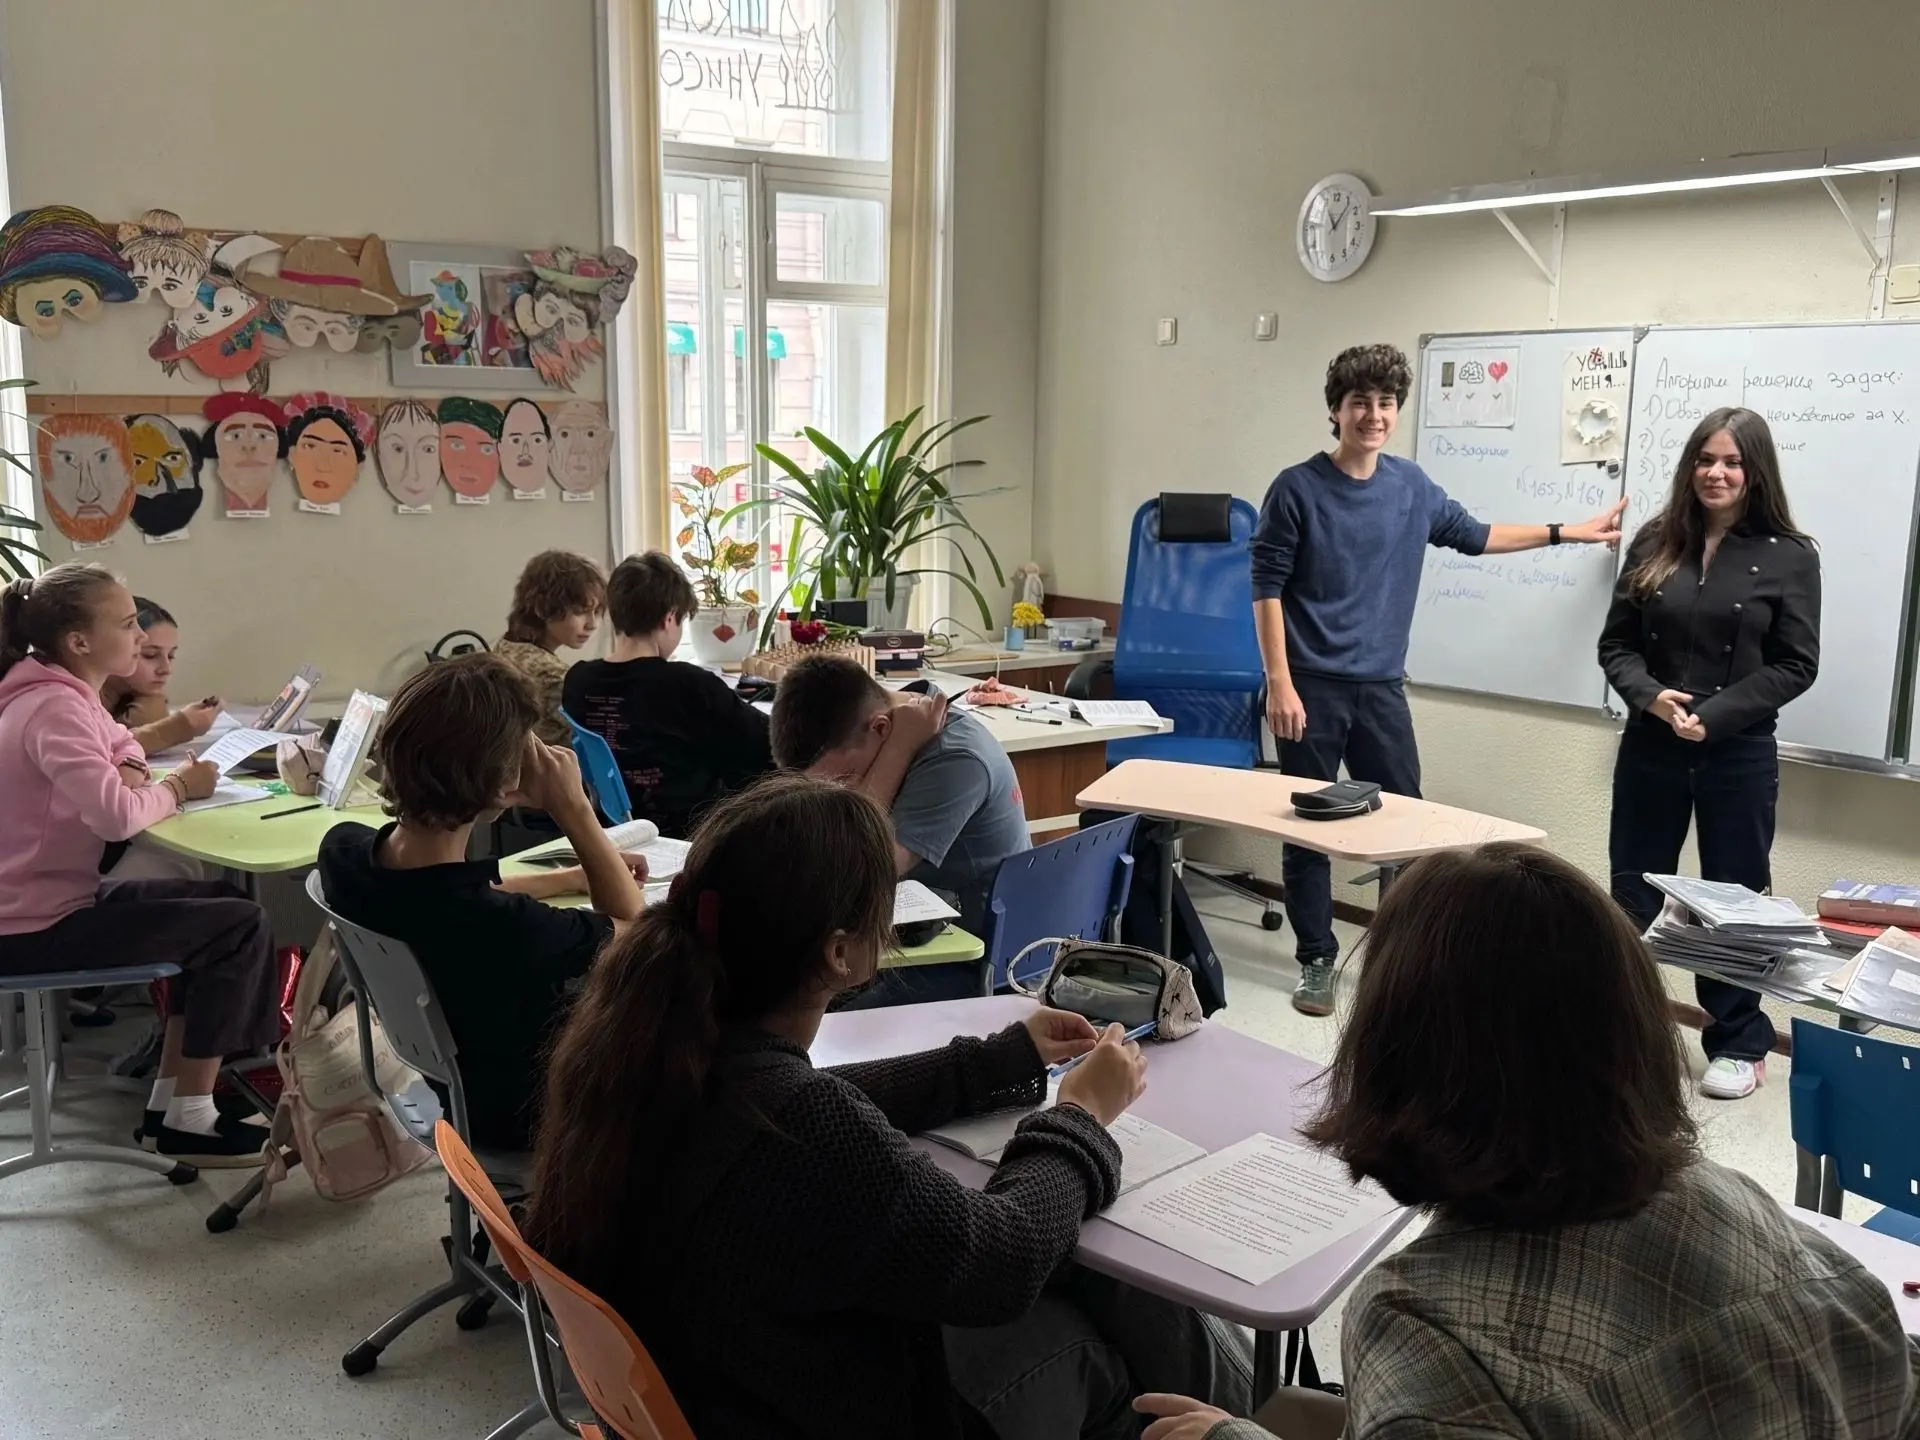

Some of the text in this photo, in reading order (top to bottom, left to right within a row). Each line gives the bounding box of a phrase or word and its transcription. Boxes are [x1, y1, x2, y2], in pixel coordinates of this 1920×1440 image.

[1333, 192, 1341, 202] 12
[1353, 206, 1358, 215] 2
[1355, 221, 1361, 231] 3
[1350, 237, 1356, 246] 4
[1342, 248, 1347, 258] 5
[1329, 254, 1335, 263] 6
[1866, 411, 1884, 421] за
